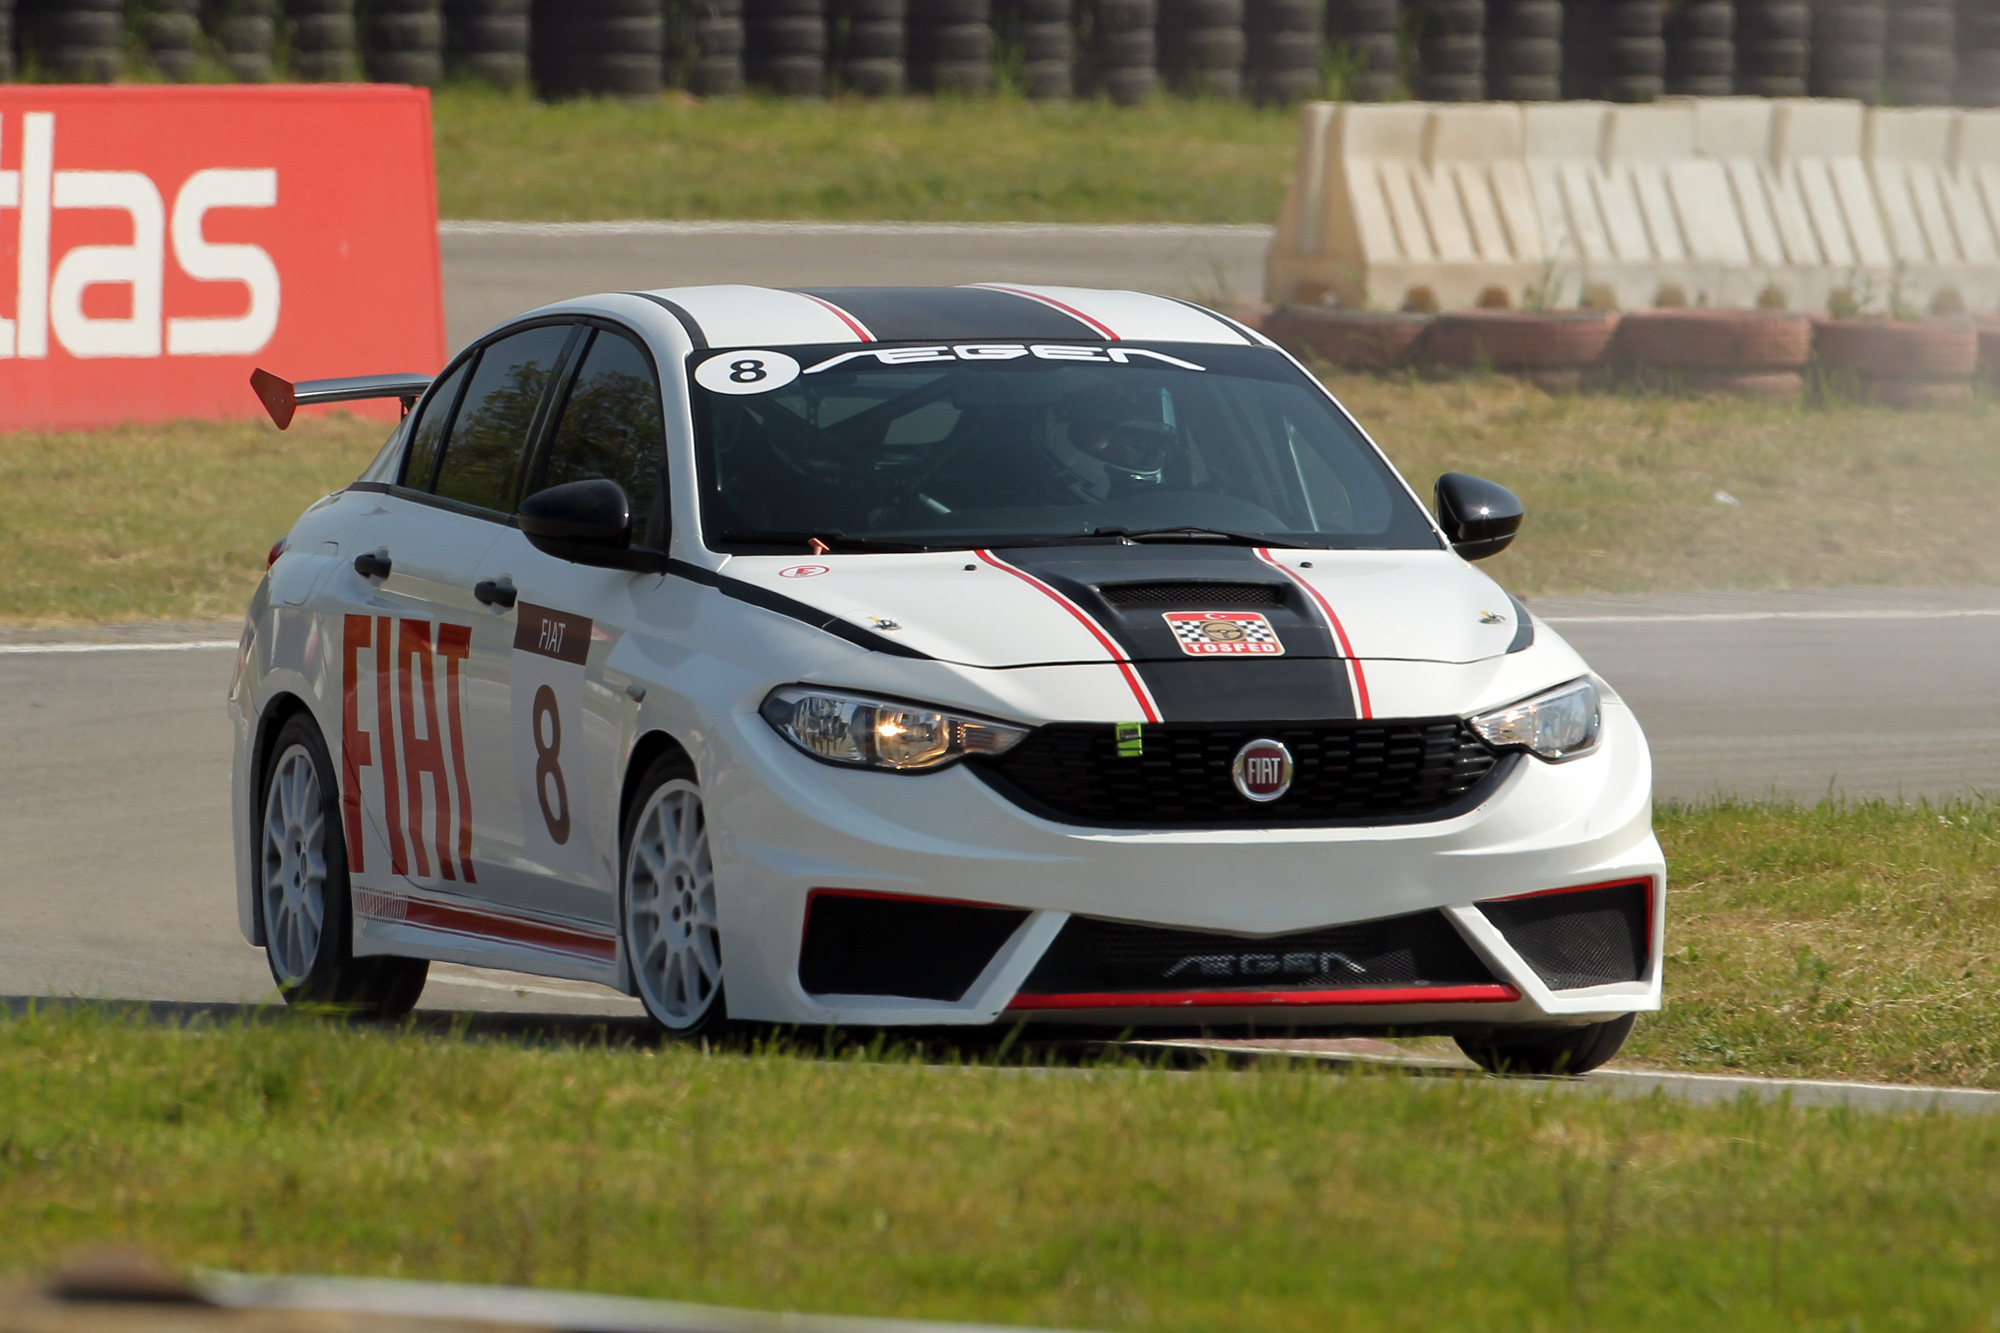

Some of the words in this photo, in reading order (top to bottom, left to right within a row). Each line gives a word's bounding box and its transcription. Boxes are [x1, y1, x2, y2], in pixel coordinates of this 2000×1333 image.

[729, 359, 767, 383] 8
[539, 618, 566, 653] FIAT
[1188, 643, 1276, 653] TOSFED
[342, 613, 478, 884] FIAT
[532, 684, 571, 846] 8
[1247, 757, 1281, 785] FIAT
